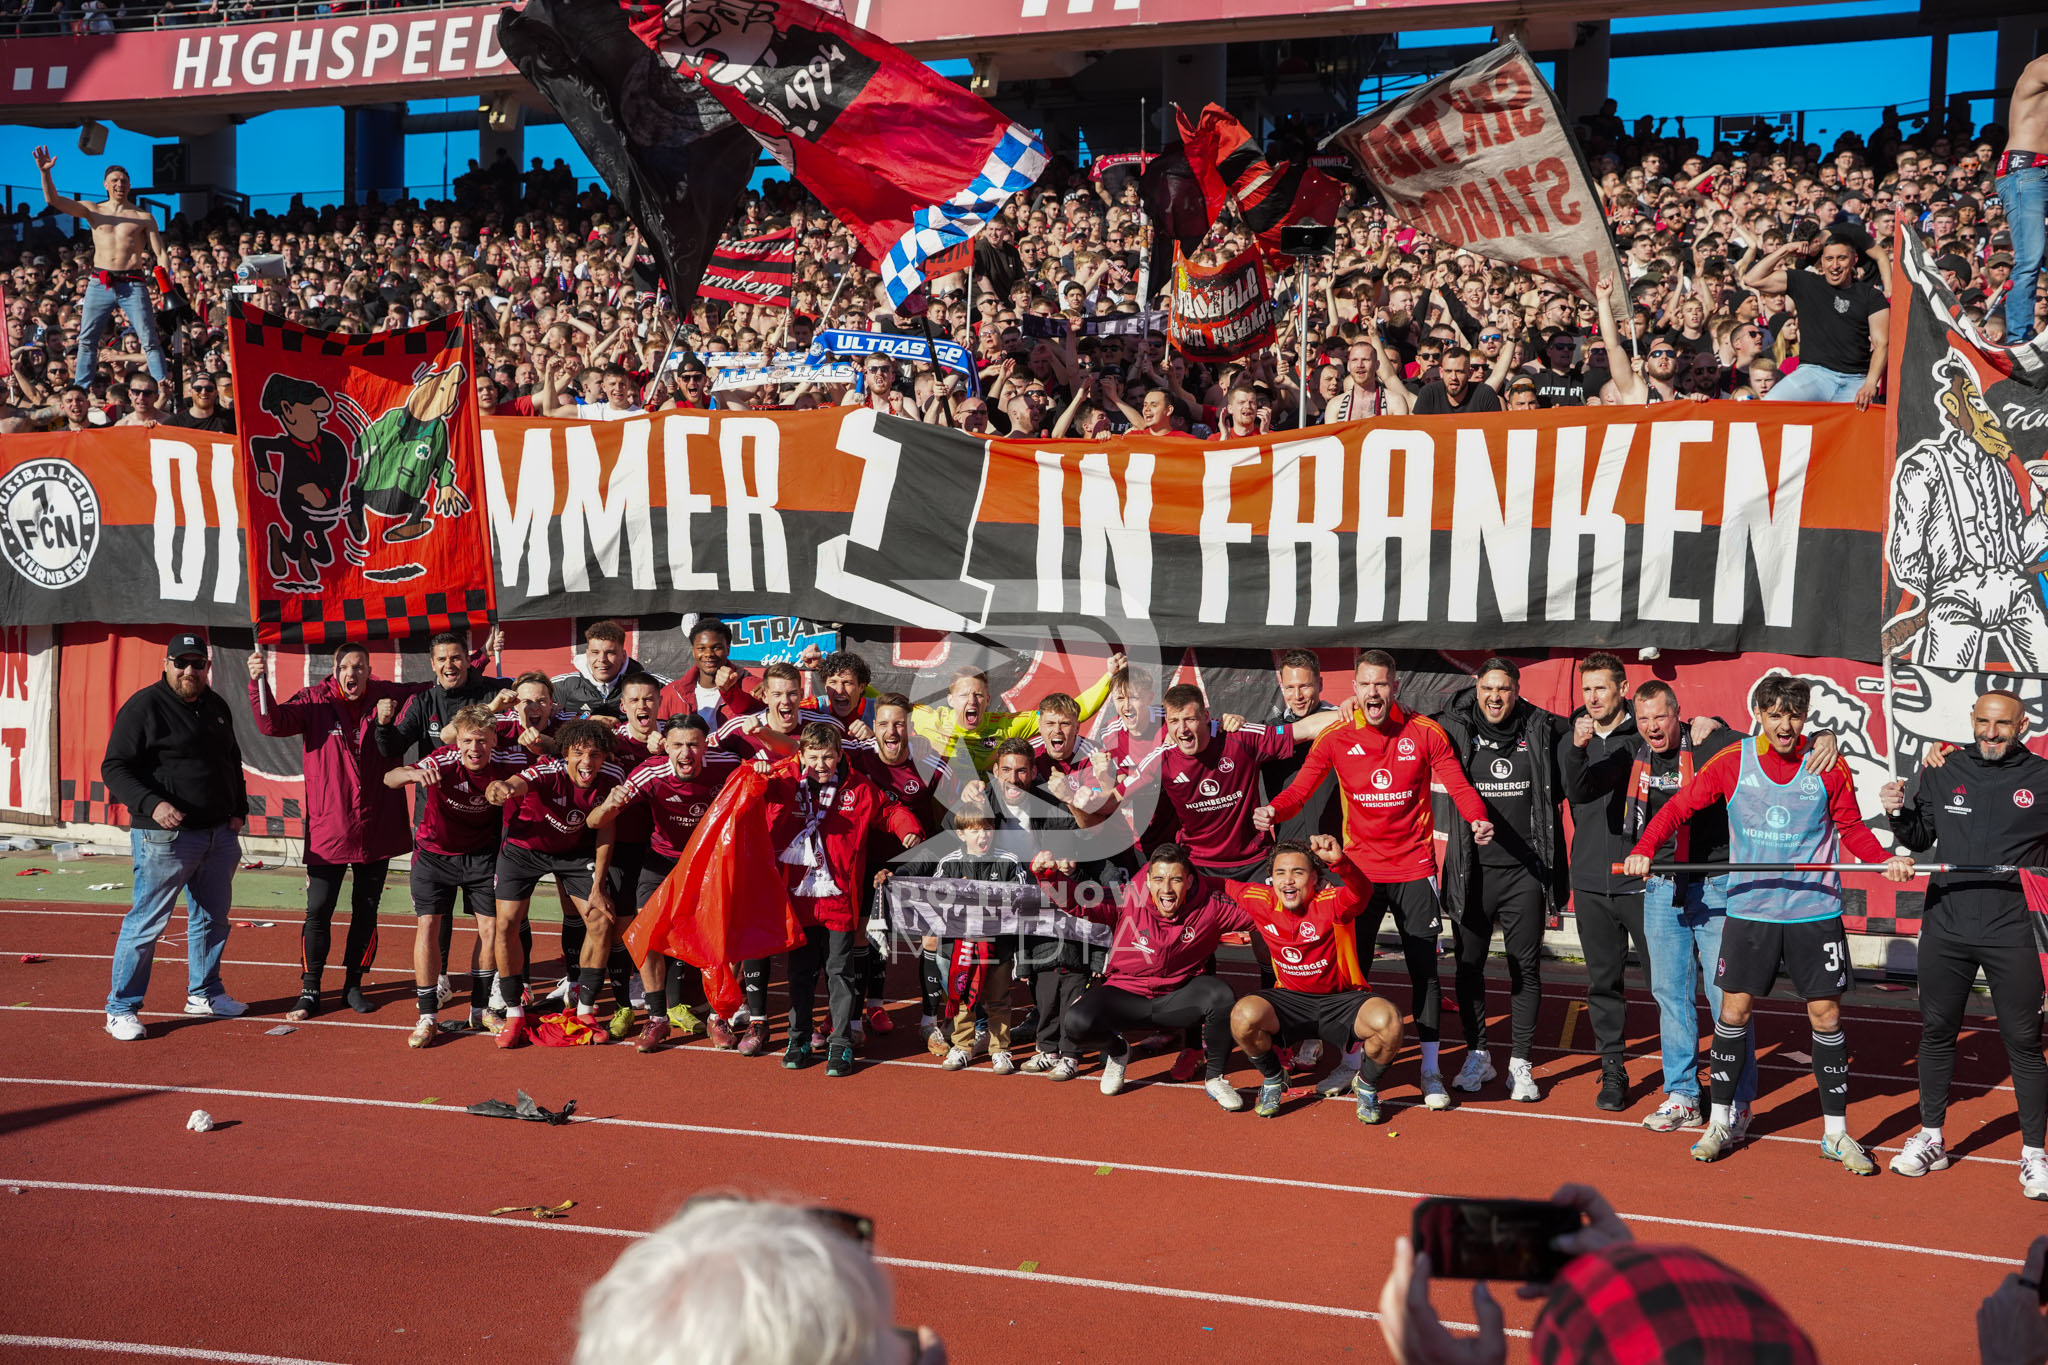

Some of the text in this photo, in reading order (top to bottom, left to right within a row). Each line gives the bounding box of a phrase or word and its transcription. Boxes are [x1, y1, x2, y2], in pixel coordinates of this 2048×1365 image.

[172, 14, 509, 90] HIGHSPEED
[16, 514, 78, 550] FCN
[150, 438, 241, 605] DI
[480, 414, 791, 599] MMER
[1034, 450, 1156, 620] IN
[1198, 420, 1813, 628] FRANKEN
[729, 616, 839, 648] LTRA
[1353, 790, 1412, 802] NÜRNBERGER
